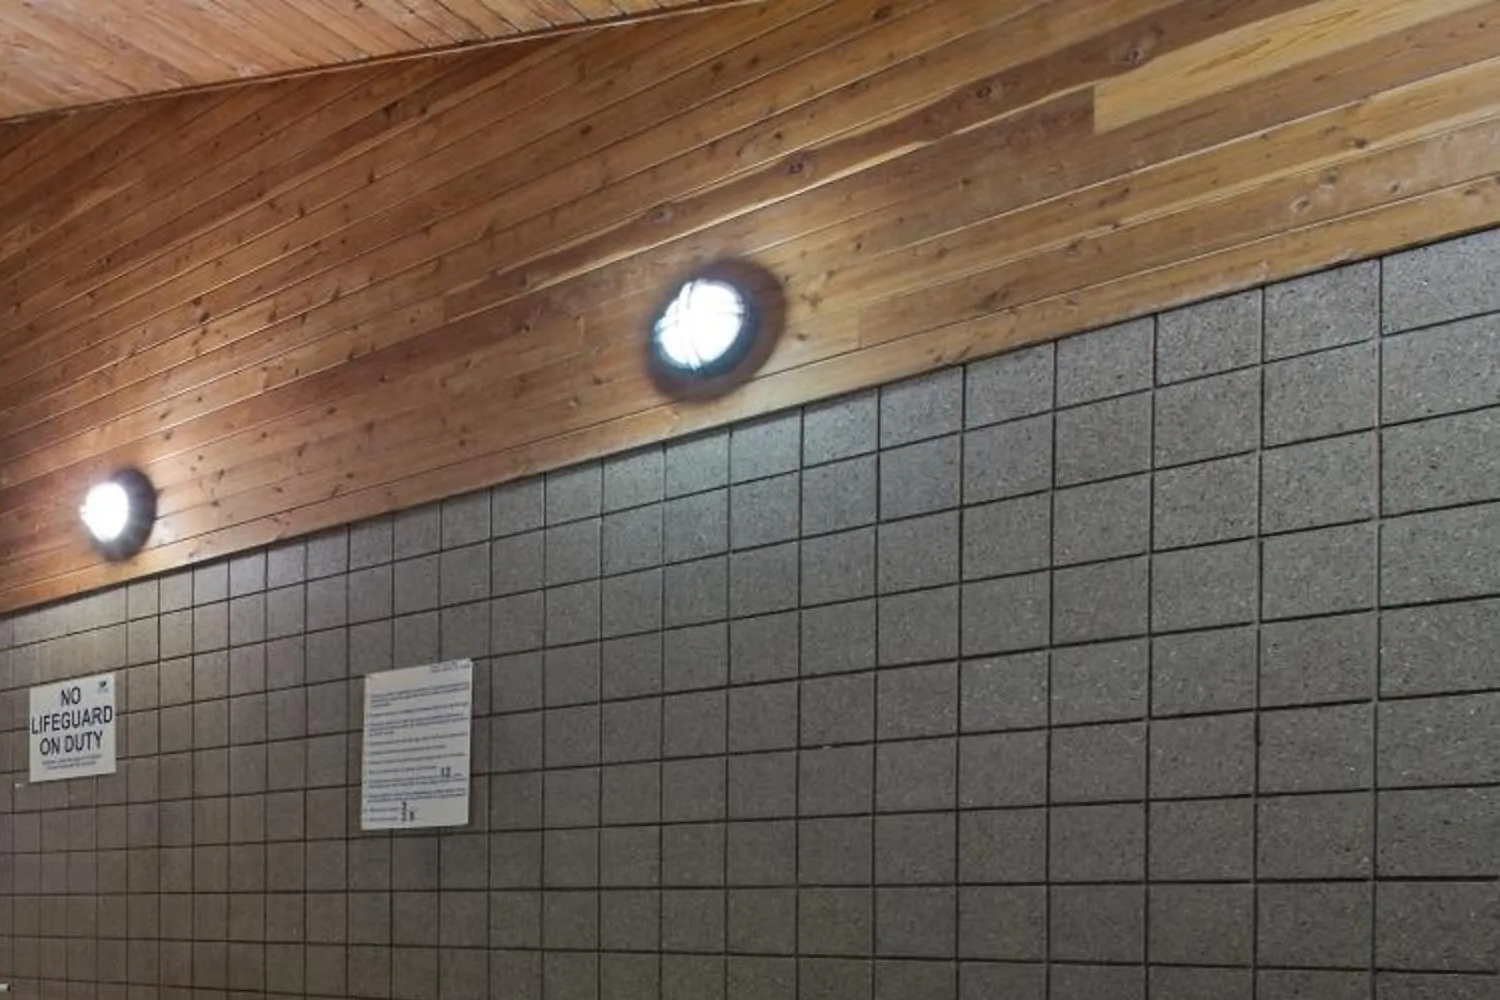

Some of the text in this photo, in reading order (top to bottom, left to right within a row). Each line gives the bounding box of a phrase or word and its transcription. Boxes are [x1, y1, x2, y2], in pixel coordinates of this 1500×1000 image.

[61, 686, 81, 707] NO
[31, 705, 113, 735] LIFEGUARD
[39, 730, 103, 756] ON DUTY
